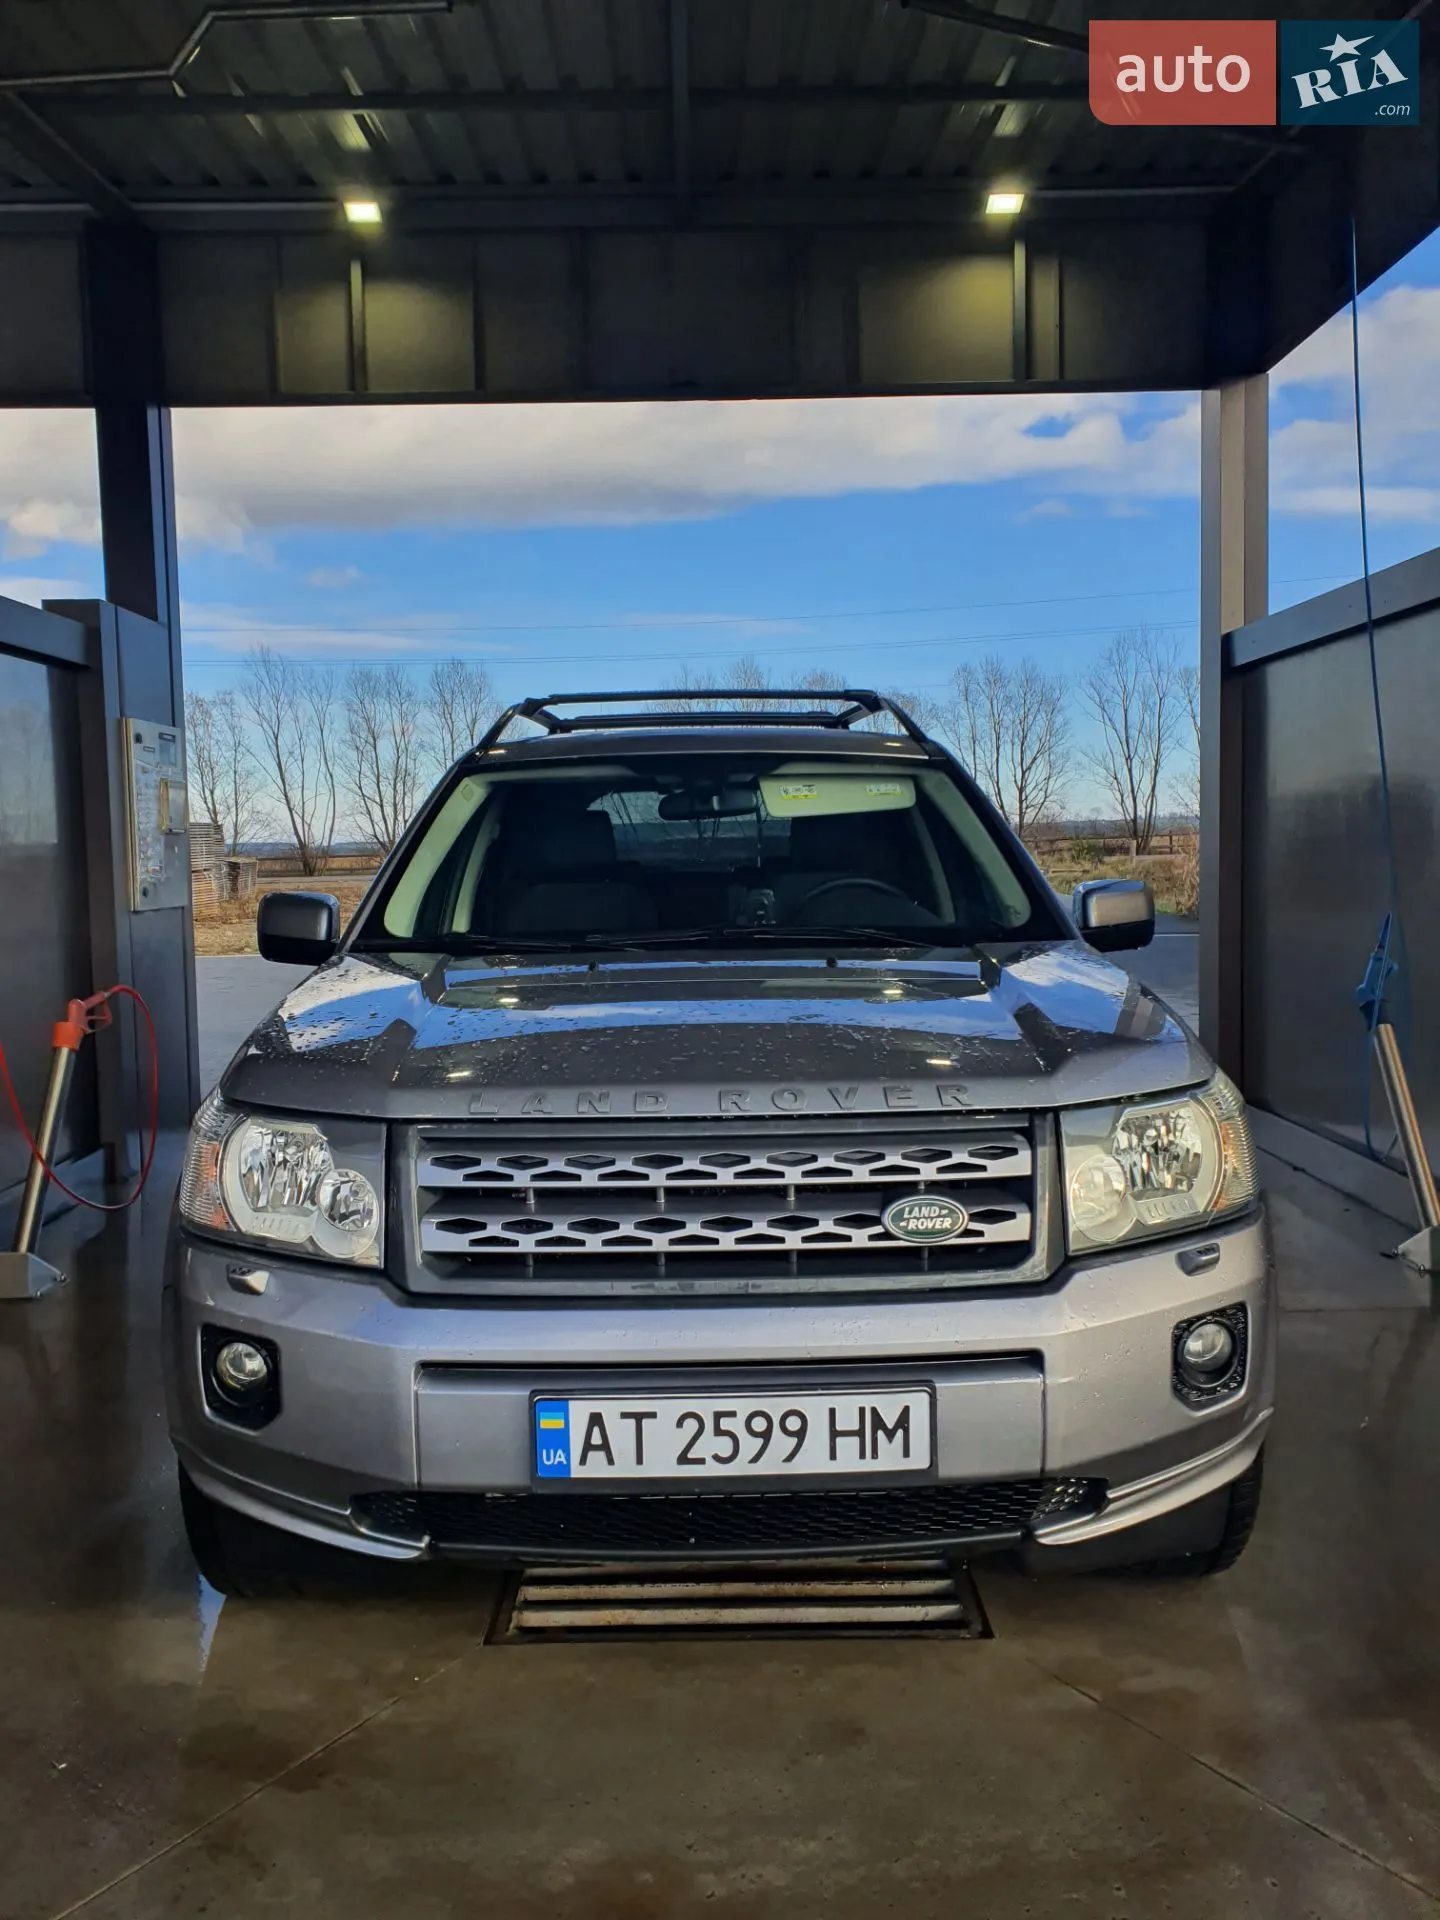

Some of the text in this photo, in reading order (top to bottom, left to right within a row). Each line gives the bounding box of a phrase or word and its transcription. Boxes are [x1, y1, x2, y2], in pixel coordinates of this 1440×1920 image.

[468, 1084, 973, 1114] LAND ROVER
[578, 1404, 910, 1466] AT 2599 HM
[542, 1449, 567, 1465] UA
